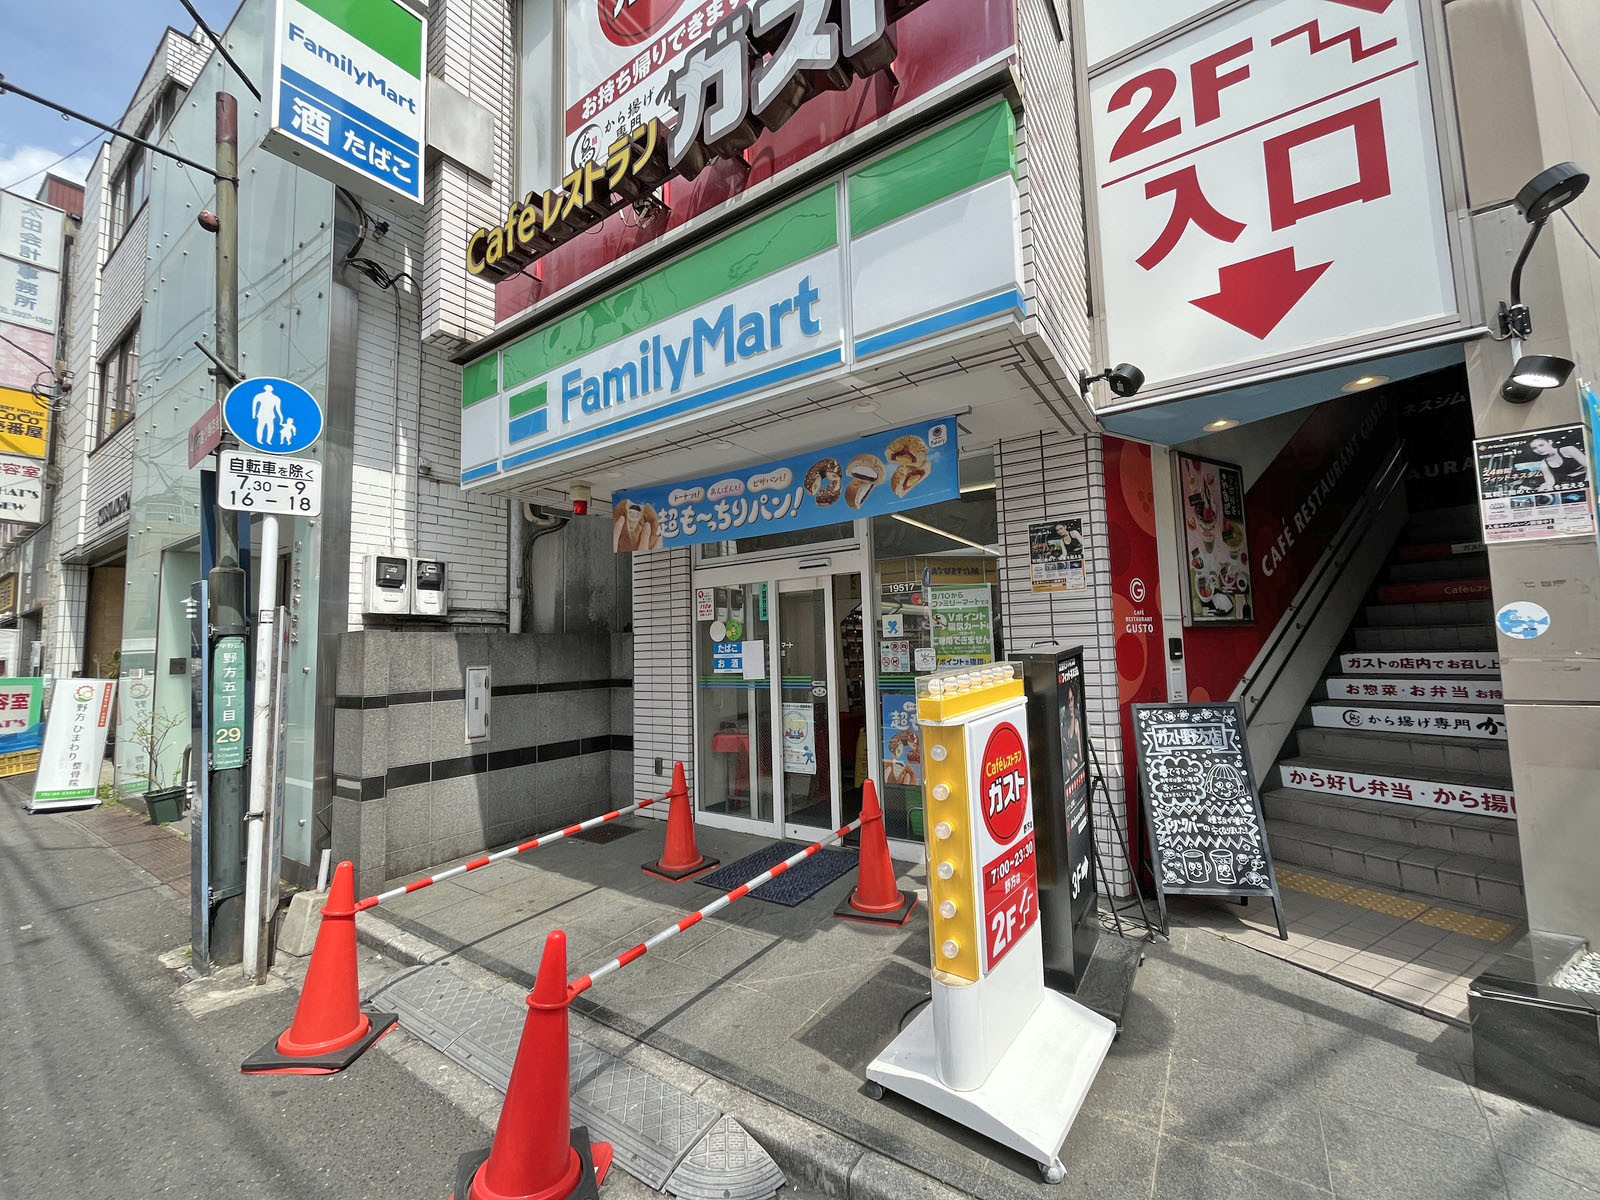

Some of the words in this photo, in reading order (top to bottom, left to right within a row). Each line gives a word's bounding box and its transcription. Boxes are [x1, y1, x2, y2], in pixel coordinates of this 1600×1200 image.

[287, 21, 417, 115] FamilyMart
[1107, 36, 1254, 163] 2F
[291, 97, 332, 146] 酒
[342, 129, 413, 184] たばこ
[1135, 97, 1391, 272] 入口
[561, 275, 822, 424] FamilyMart
[0, 463, 40, 478] 容室
[229, 457, 314, 480] 自転車を除く
[0, 502, 26, 510] EW
[1261, 515, 1296, 577] CAFÉ
[1293, 432, 1360, 535] RESTAURANT
[888, 583, 915, 593] 19517
[1126, 623, 1154, 633] GUSTO
[717, 643, 739, 654] たばこ
[222, 652, 238, 721] 野方五丁目
[75, 703, 88, 722] 野方
[69, 725, 84, 761] ひまわり
[216, 727, 241, 744] 29
[988, 769, 1025, 818] ガスト
[1072, 863, 1082, 900] 3F
[992, 903, 1017, 959] 2F
